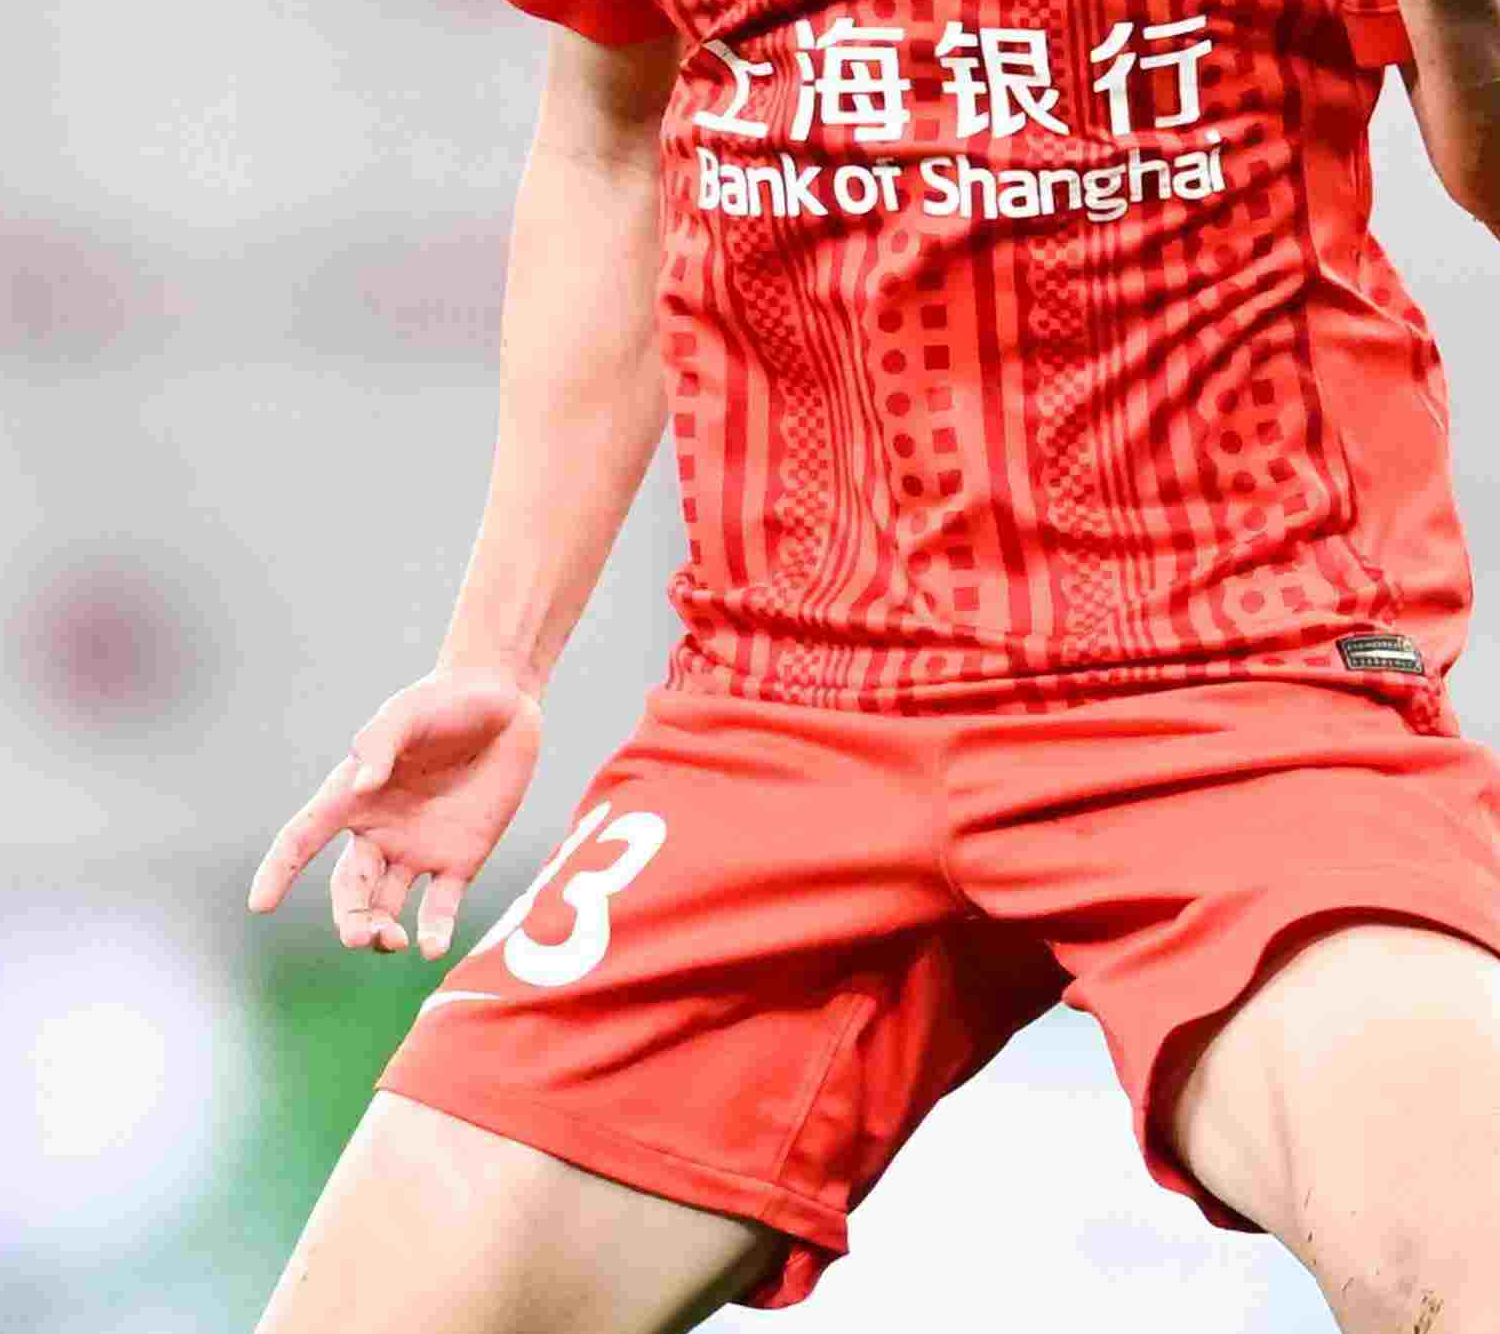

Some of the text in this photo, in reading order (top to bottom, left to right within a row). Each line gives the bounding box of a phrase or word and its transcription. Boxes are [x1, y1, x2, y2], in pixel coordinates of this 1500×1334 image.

[693, 15, 1214, 142] 上海银行
[697, 130, 1227, 221] Bank of Shanghai
[467, 800, 667, 987] 3
